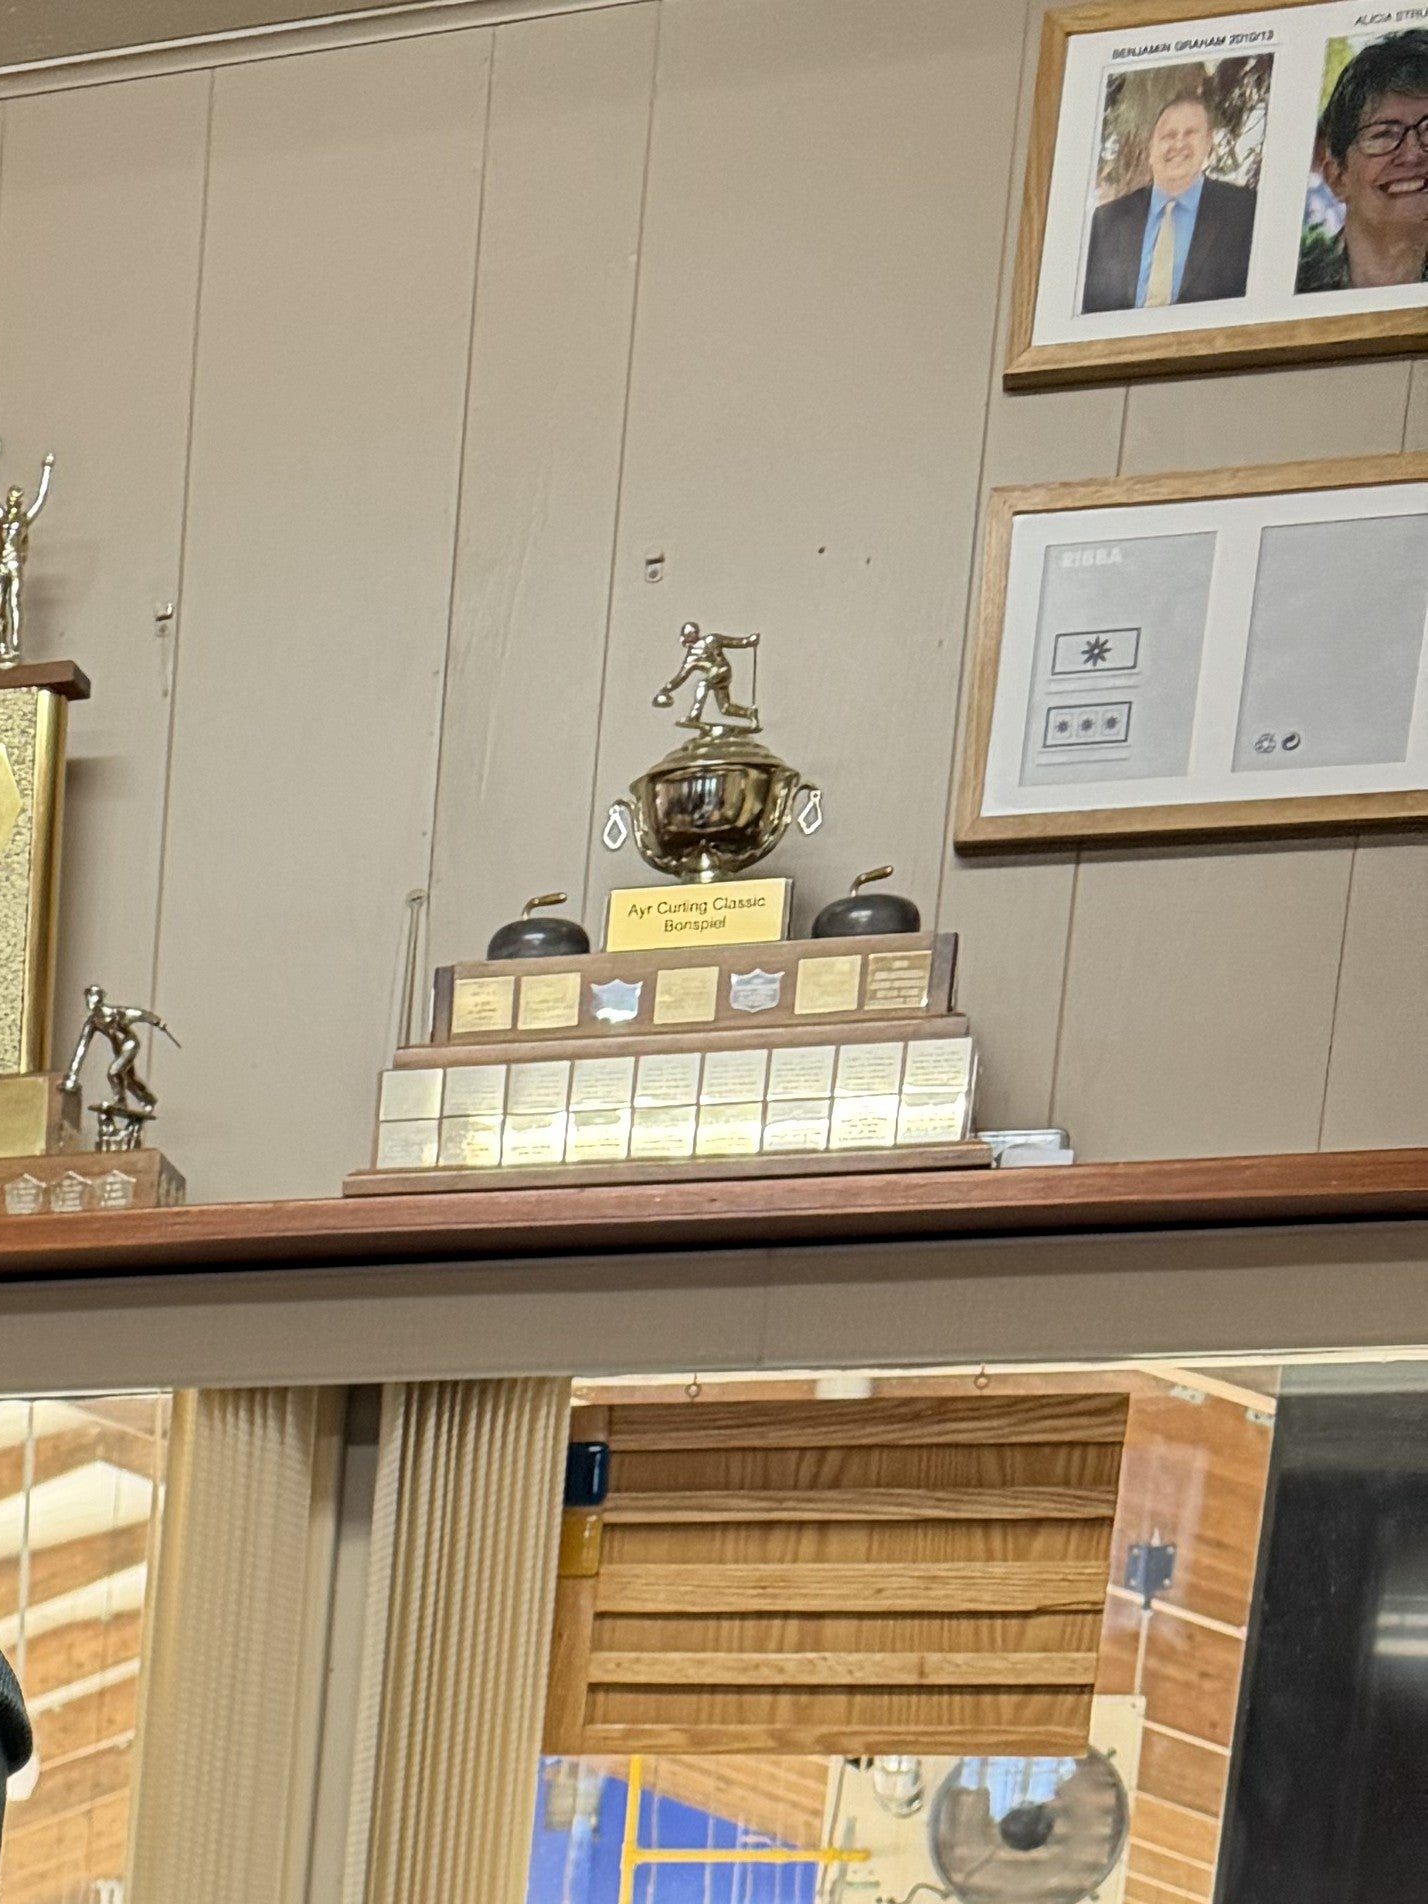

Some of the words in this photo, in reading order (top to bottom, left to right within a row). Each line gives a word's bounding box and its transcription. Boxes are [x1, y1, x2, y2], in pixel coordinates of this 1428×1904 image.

[628, 903, 653, 920] Ayr
[657, 900, 708, 916] Curling
[712, 896, 766, 911] Classic
[664, 916, 727, 933] Bonspiel
